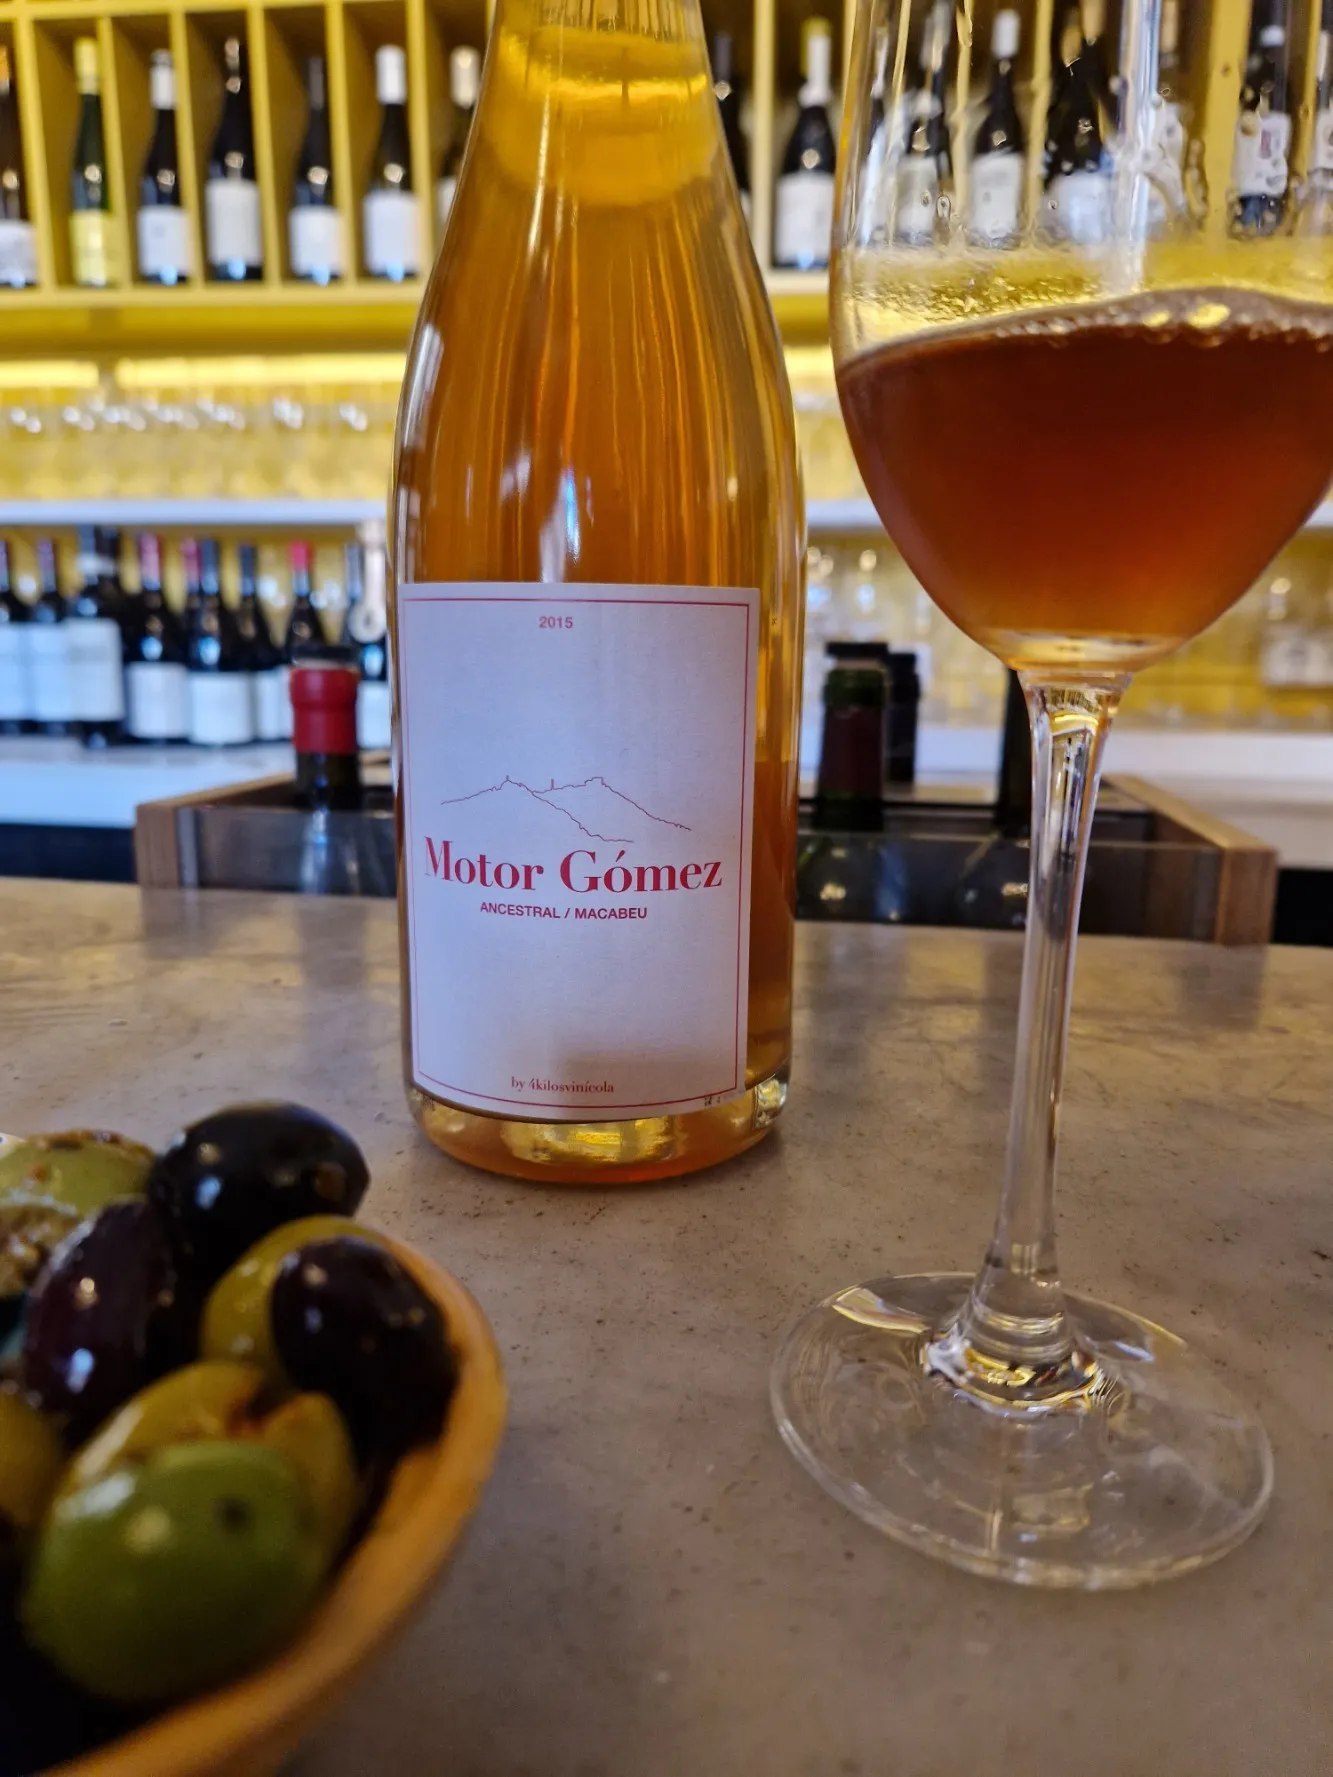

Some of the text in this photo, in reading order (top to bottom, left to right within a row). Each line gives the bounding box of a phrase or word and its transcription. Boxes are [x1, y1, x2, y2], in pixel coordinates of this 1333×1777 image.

[538, 615, 574, 630] 2015
[424, 836, 723, 893] Motor Gómez
[480, 901, 648, 920] ANCESTRAL / MACABEU
[511, 1076, 526, 1092] by
